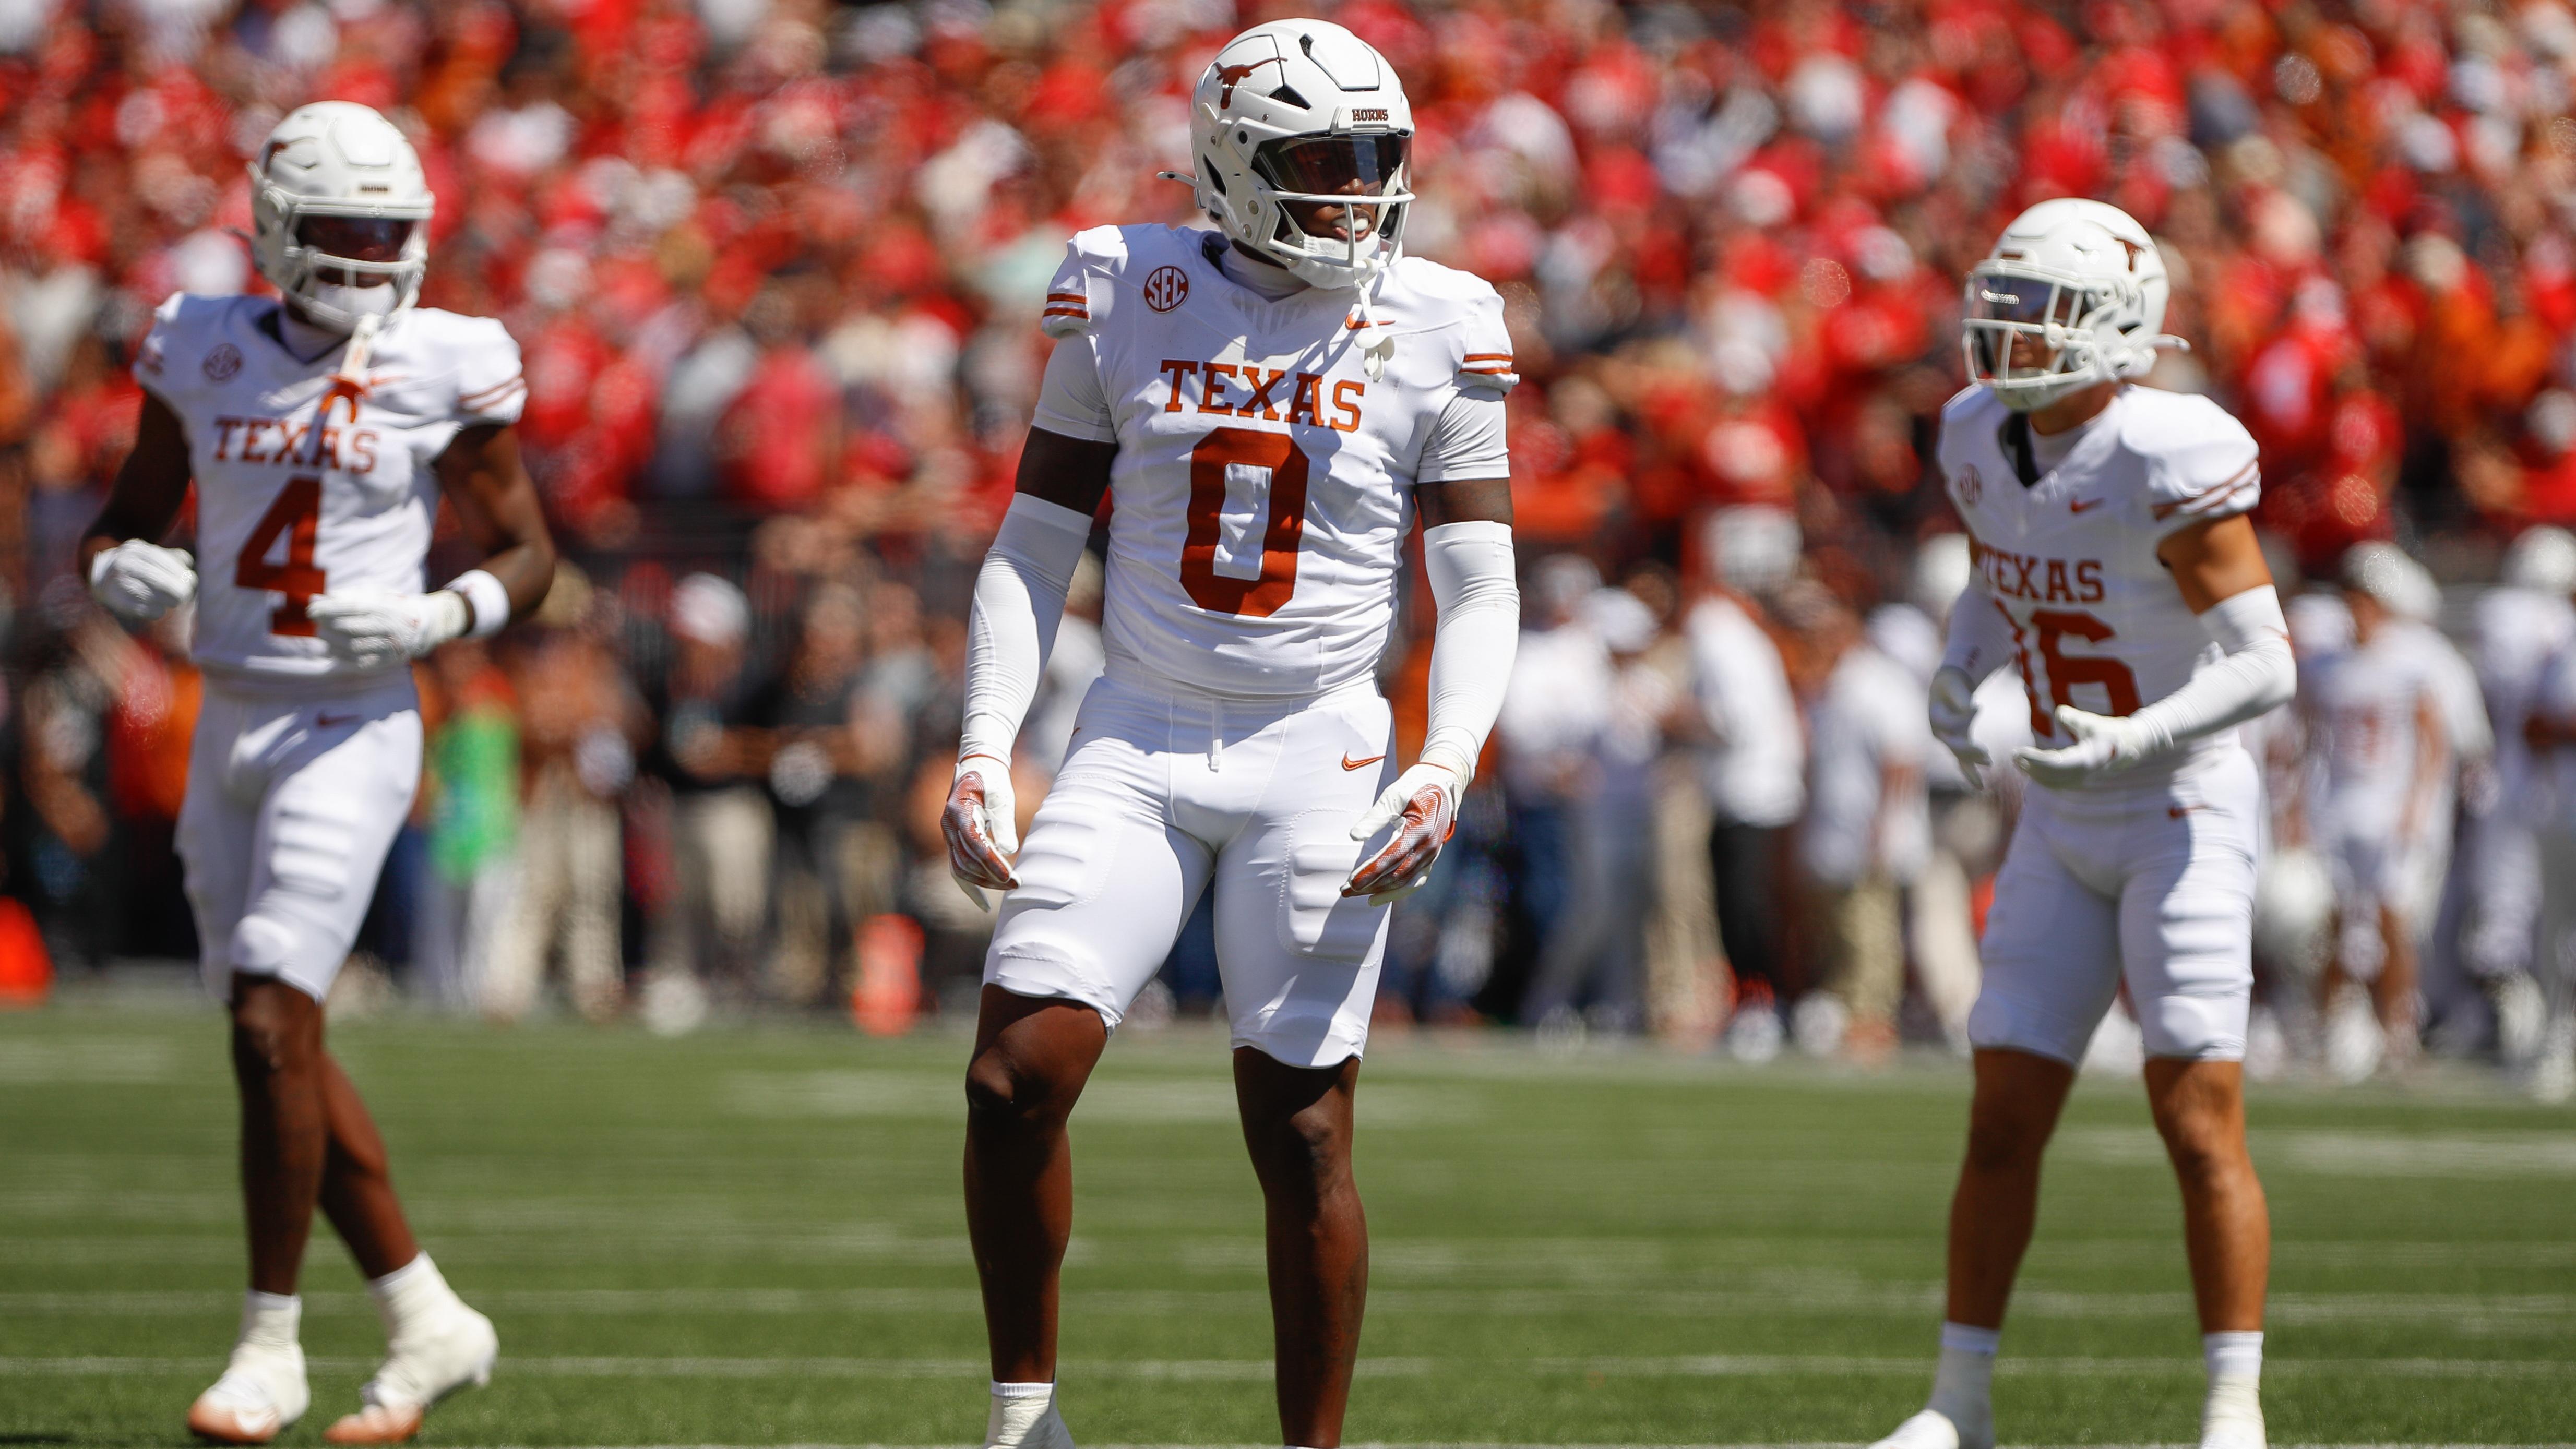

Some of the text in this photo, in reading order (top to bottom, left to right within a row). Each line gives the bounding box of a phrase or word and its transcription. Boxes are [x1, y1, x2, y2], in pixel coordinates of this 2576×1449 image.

[1352, 109, 1388, 121] HORNS
[1147, 267, 1186, 309] SEC
[1160, 360, 1365, 433] TEXAS
[214, 418, 379, 474] TEXAS
[1179, 426, 1310, 618] 0
[235, 475, 327, 638] 4
[1980, 542, 2105, 603] TEXAS
